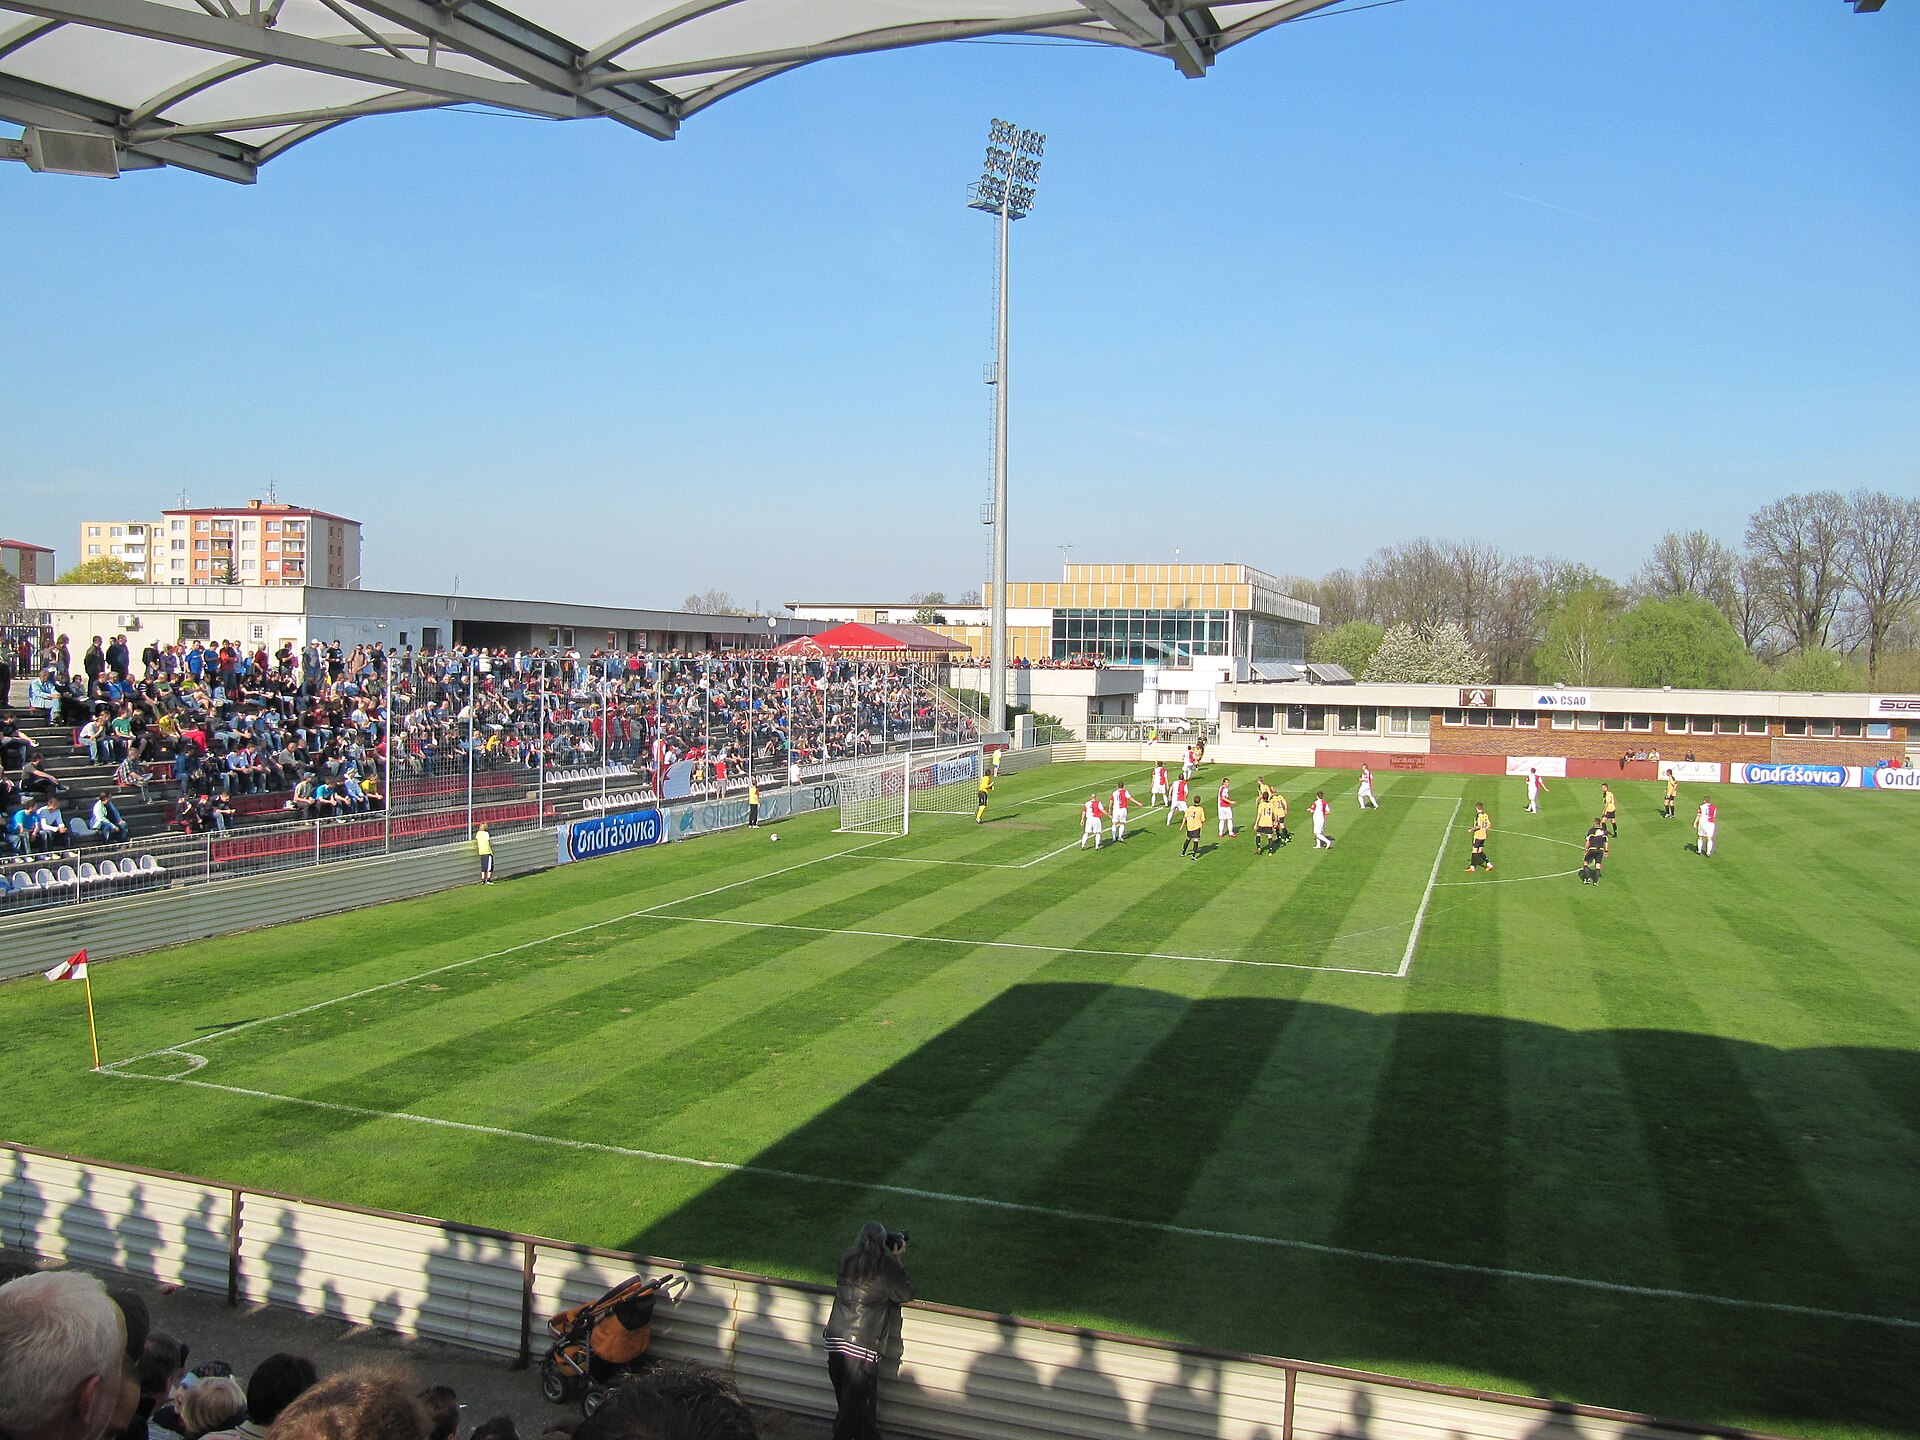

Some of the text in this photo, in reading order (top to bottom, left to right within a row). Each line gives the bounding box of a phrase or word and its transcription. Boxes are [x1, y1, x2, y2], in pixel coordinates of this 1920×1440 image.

[1560, 695, 1586, 706] CSAO
[1750, 766, 1840, 784] Ondrášovka
[577, 818, 656, 854] Ondrášovka
